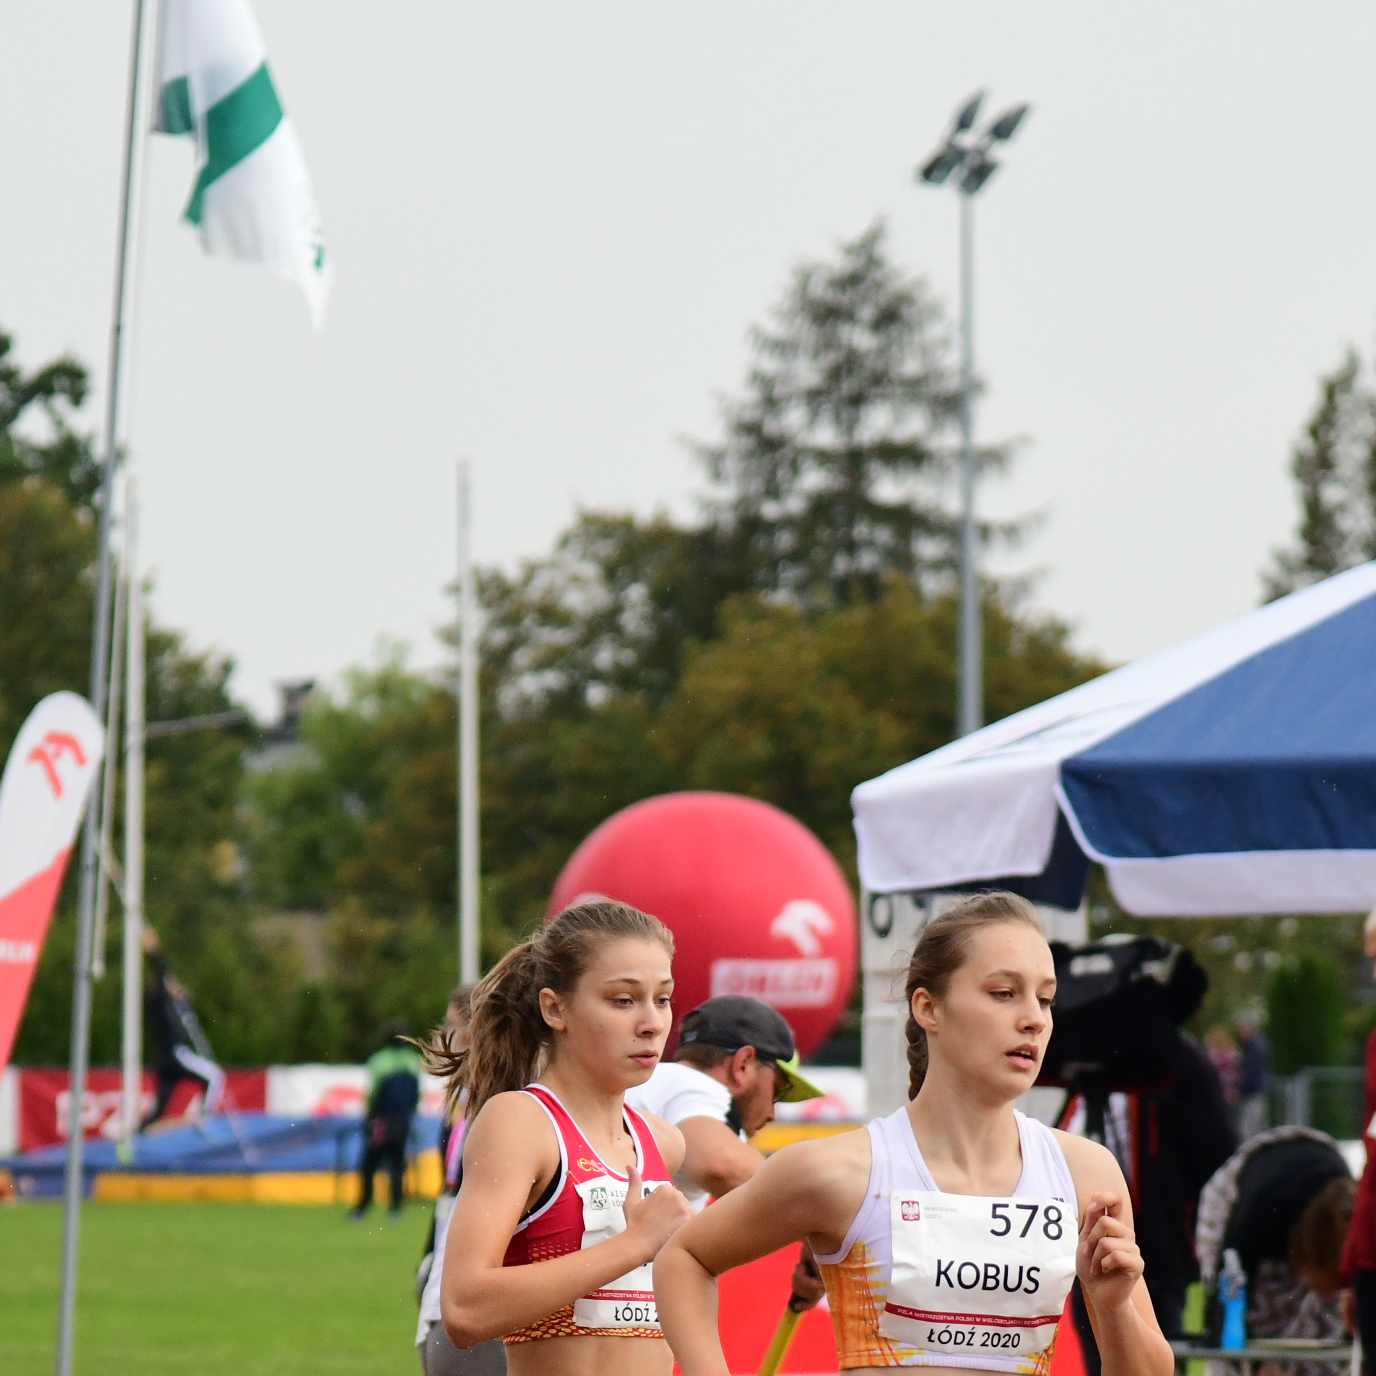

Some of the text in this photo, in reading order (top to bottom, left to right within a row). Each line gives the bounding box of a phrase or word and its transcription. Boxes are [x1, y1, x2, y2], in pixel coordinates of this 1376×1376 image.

[989, 1203, 1064, 1241] 578
[934, 1258, 1041, 1295] KOBUS
[614, 1302, 651, 1323] ŁÓDŹ
[926, 1324, 1021, 1348] ŁÓDŹ 2020
